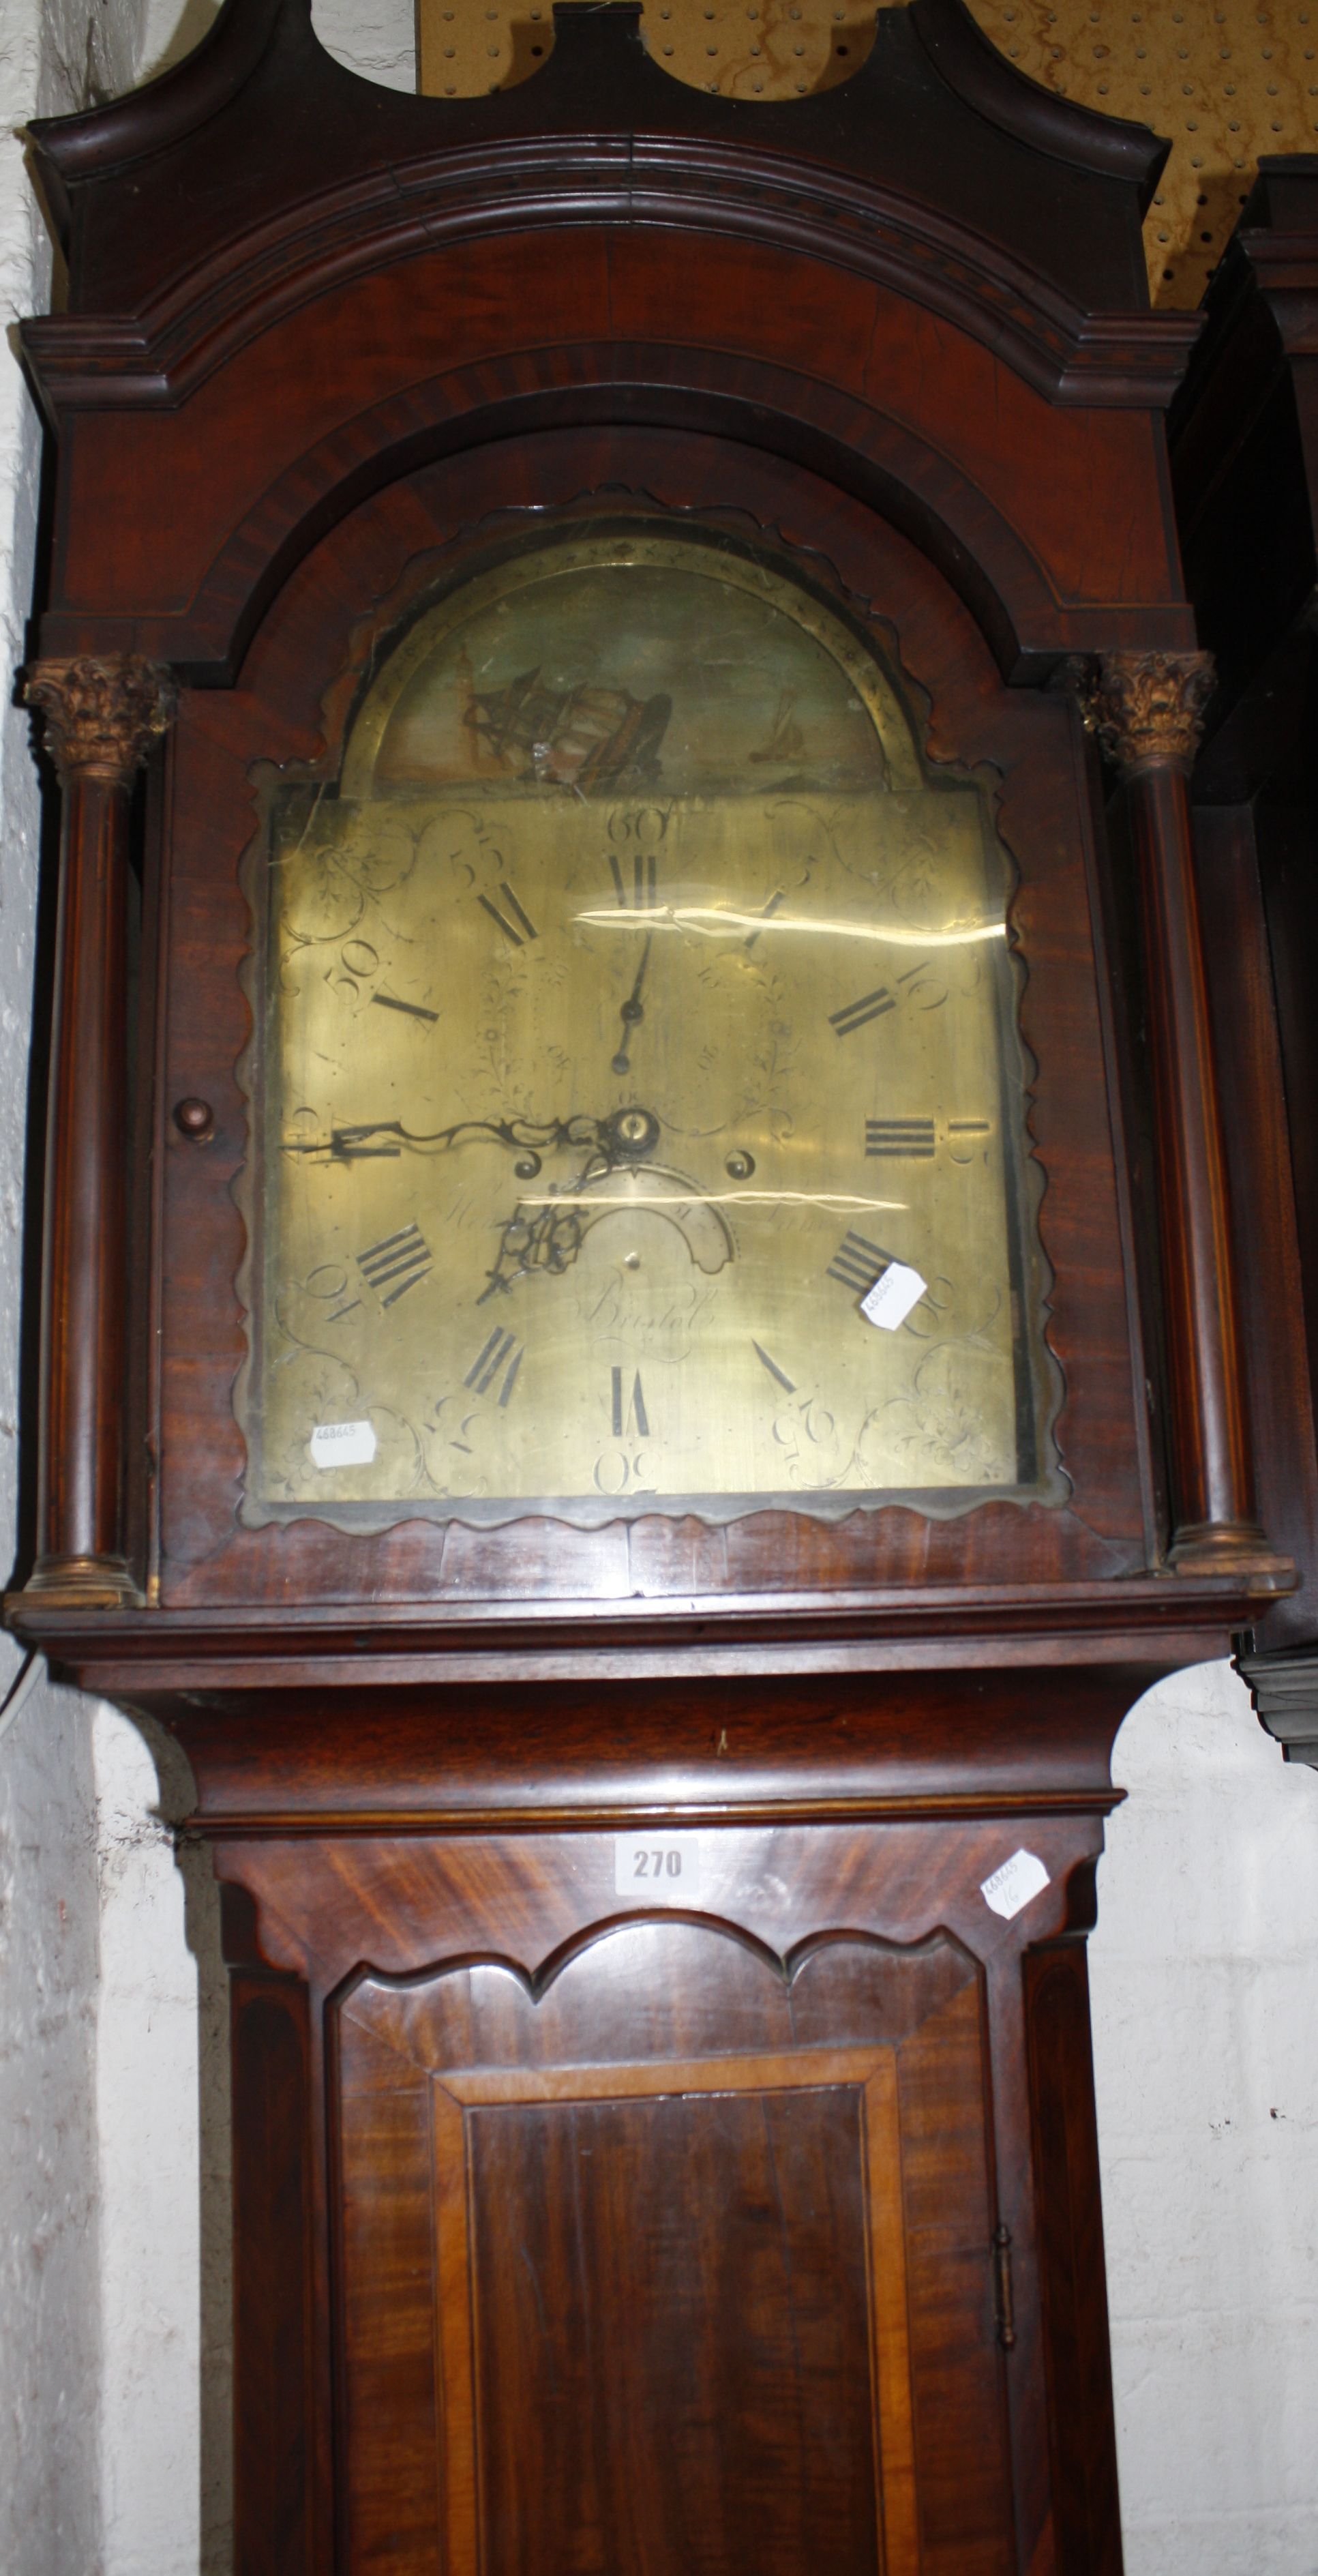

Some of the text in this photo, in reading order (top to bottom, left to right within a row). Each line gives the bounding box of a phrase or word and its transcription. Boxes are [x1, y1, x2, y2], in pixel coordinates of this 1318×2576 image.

[608, 806, 667, 844] 60
[323, 939, 379, 1006] 50
[896, 961, 950, 1011] 10
[633, 1850, 683, 1879] 270
[985, 1862, 1019, 1895] 468645
